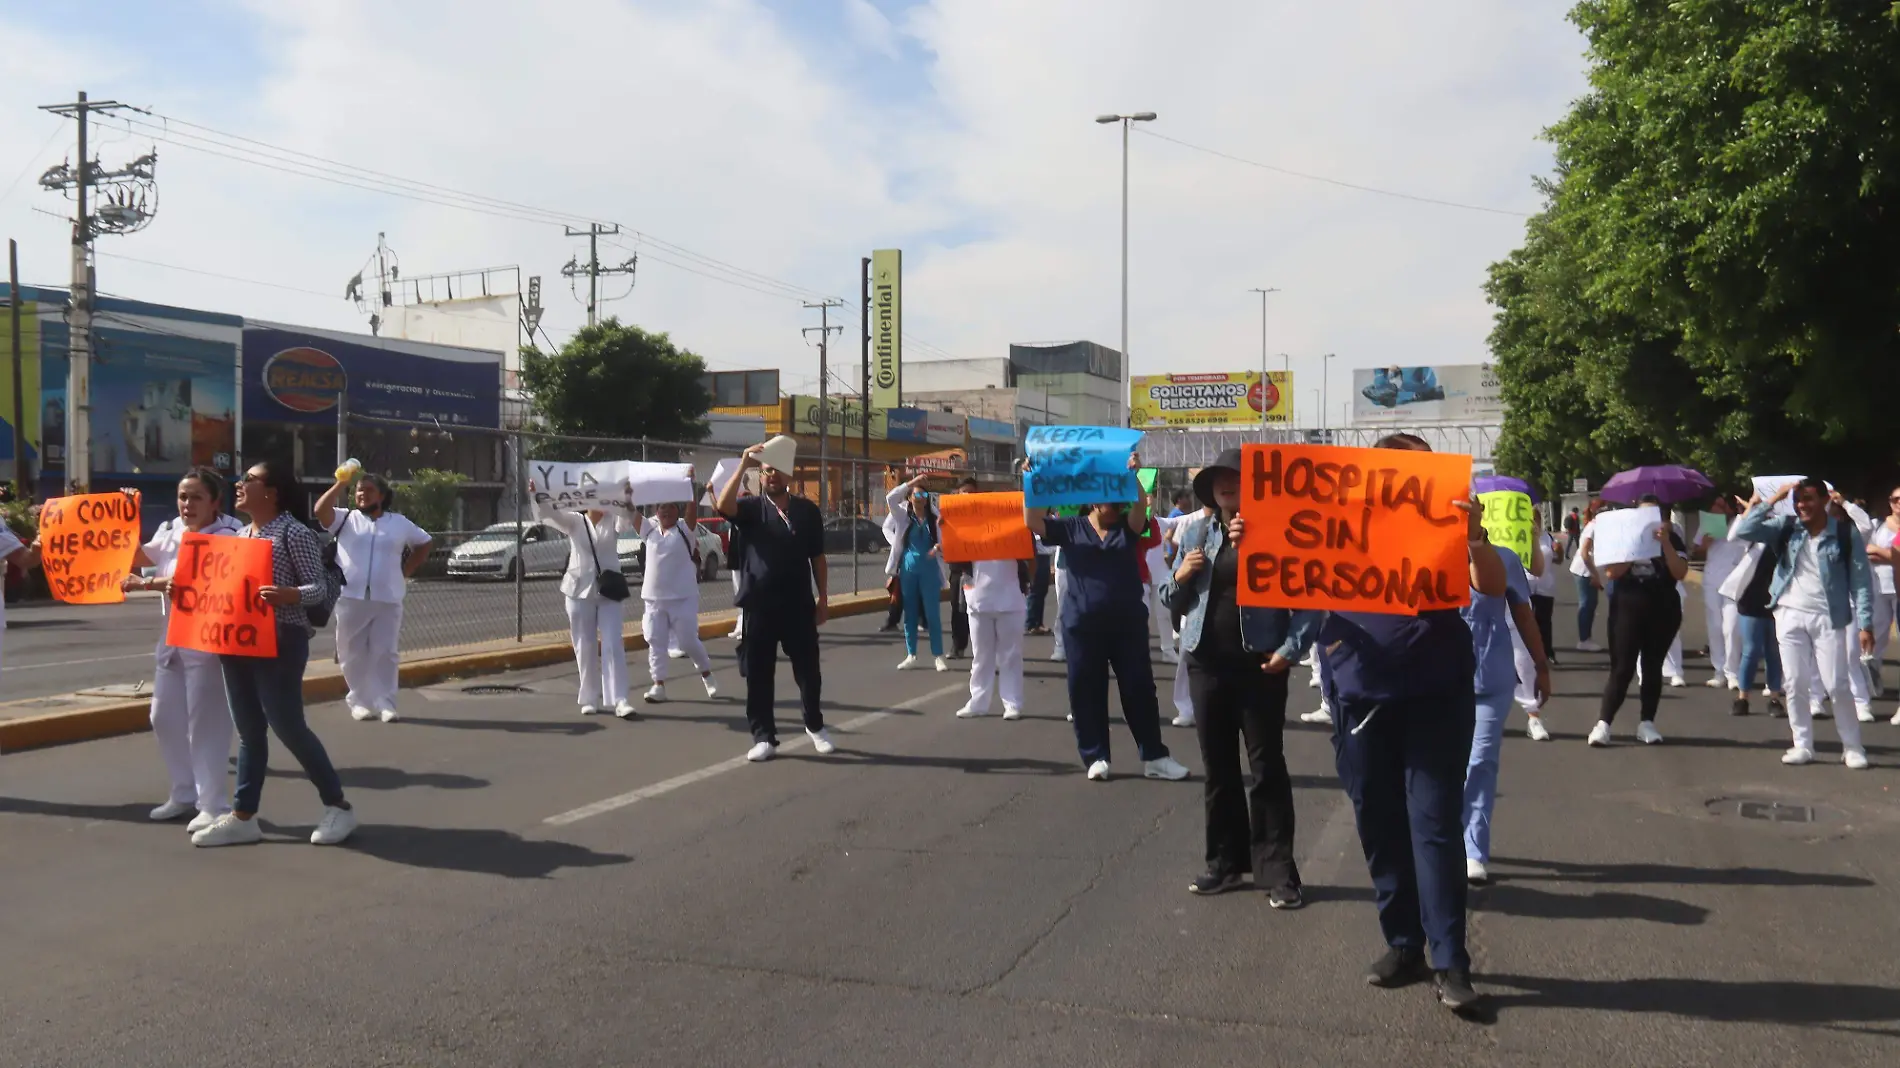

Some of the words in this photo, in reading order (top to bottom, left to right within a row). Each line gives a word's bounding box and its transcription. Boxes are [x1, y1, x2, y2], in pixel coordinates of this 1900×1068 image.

[877, 284, 895, 389] Continental
[1151, 384, 1246, 398] SOLICITAMOS
[1161, 397, 1236, 409] PERSONAL
[1031, 427, 1105, 444] ACEPTA
[538, 465, 554, 490] Y
[564, 470, 598, 486] LA
[1253, 449, 1459, 527] HOSPITAL
[77, 498, 137, 524] COVID
[1482, 498, 1502, 522] UE
[50, 529, 131, 555] HEROES
[1284, 507, 1371, 553] SIN
[1246, 552, 1462, 608] PERSONAL
[244, 575, 268, 617] la
[201, 621, 258, 648] cara
